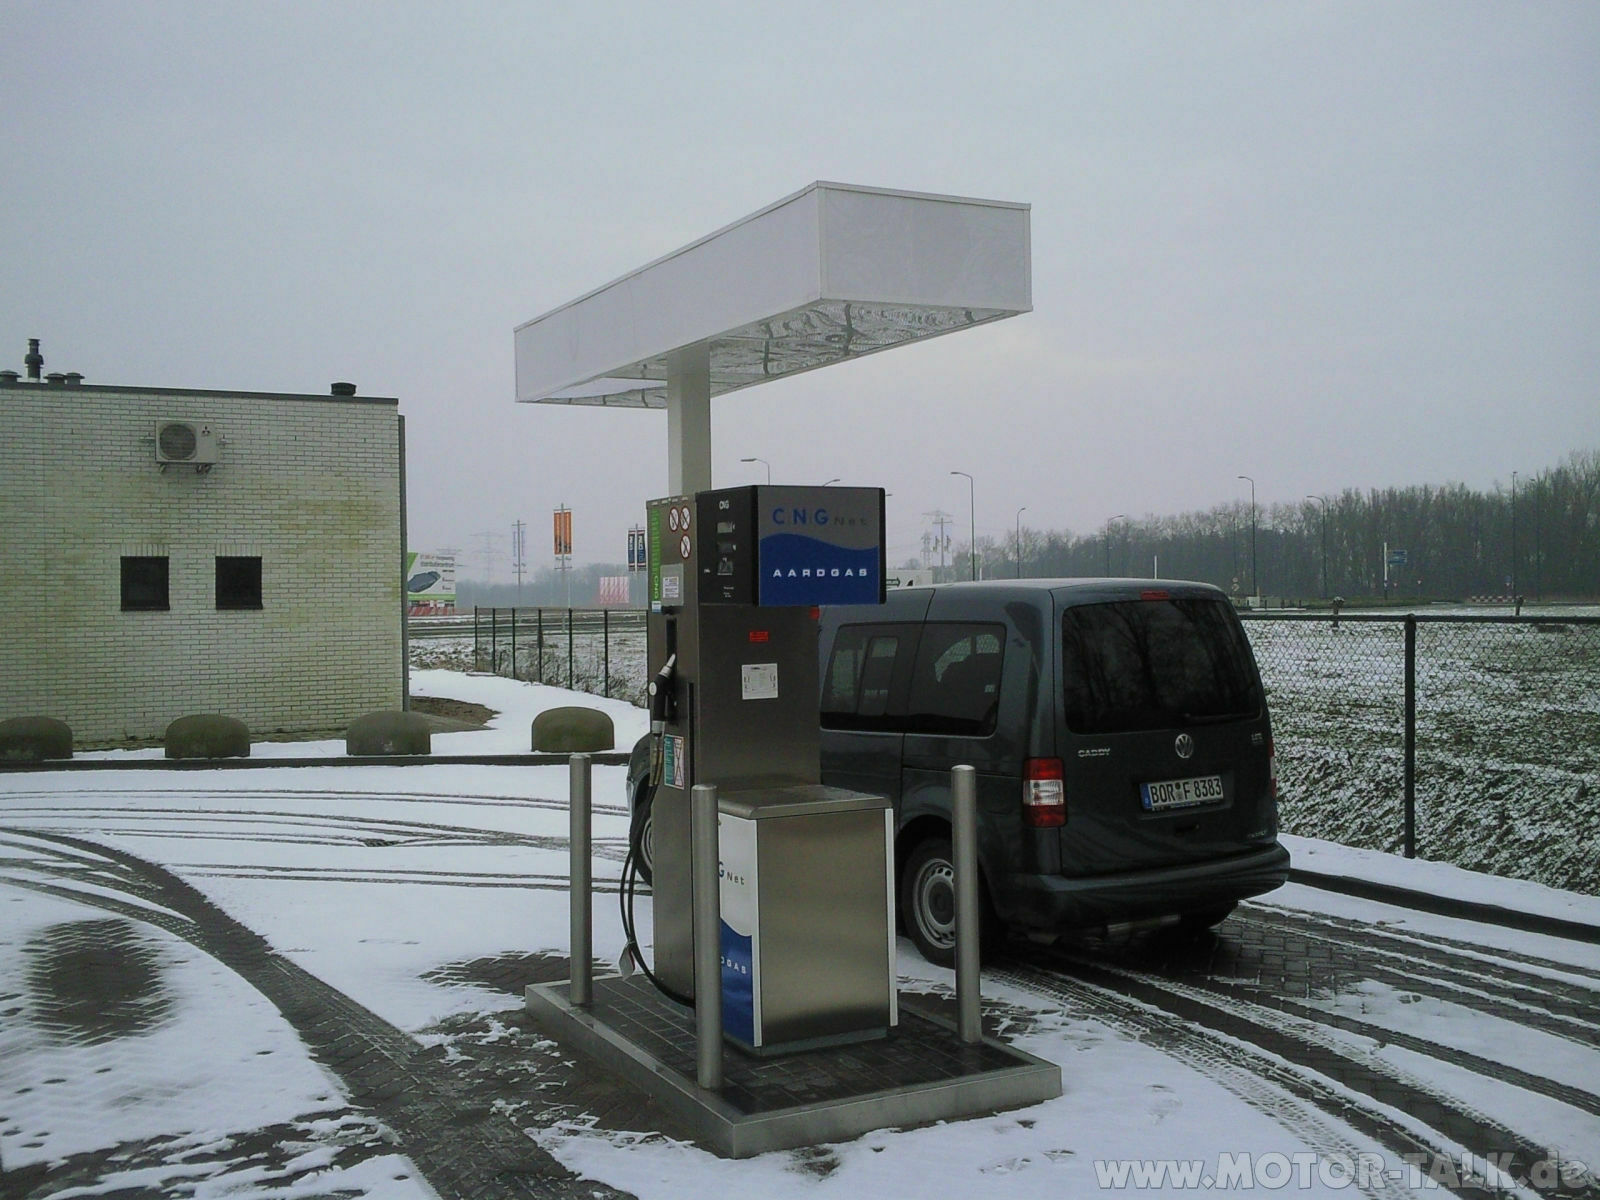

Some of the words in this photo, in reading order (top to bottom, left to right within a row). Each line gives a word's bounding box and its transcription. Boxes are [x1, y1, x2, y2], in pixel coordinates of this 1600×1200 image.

[773, 508, 829, 525] CNG
[773, 568, 868, 578] AARDGAS
[1150, 783, 1176, 804] BOR
[1182, 781, 1191, 800] F
[1193, 778, 1222, 798] 8383
[726, 871, 745, 886] Net
